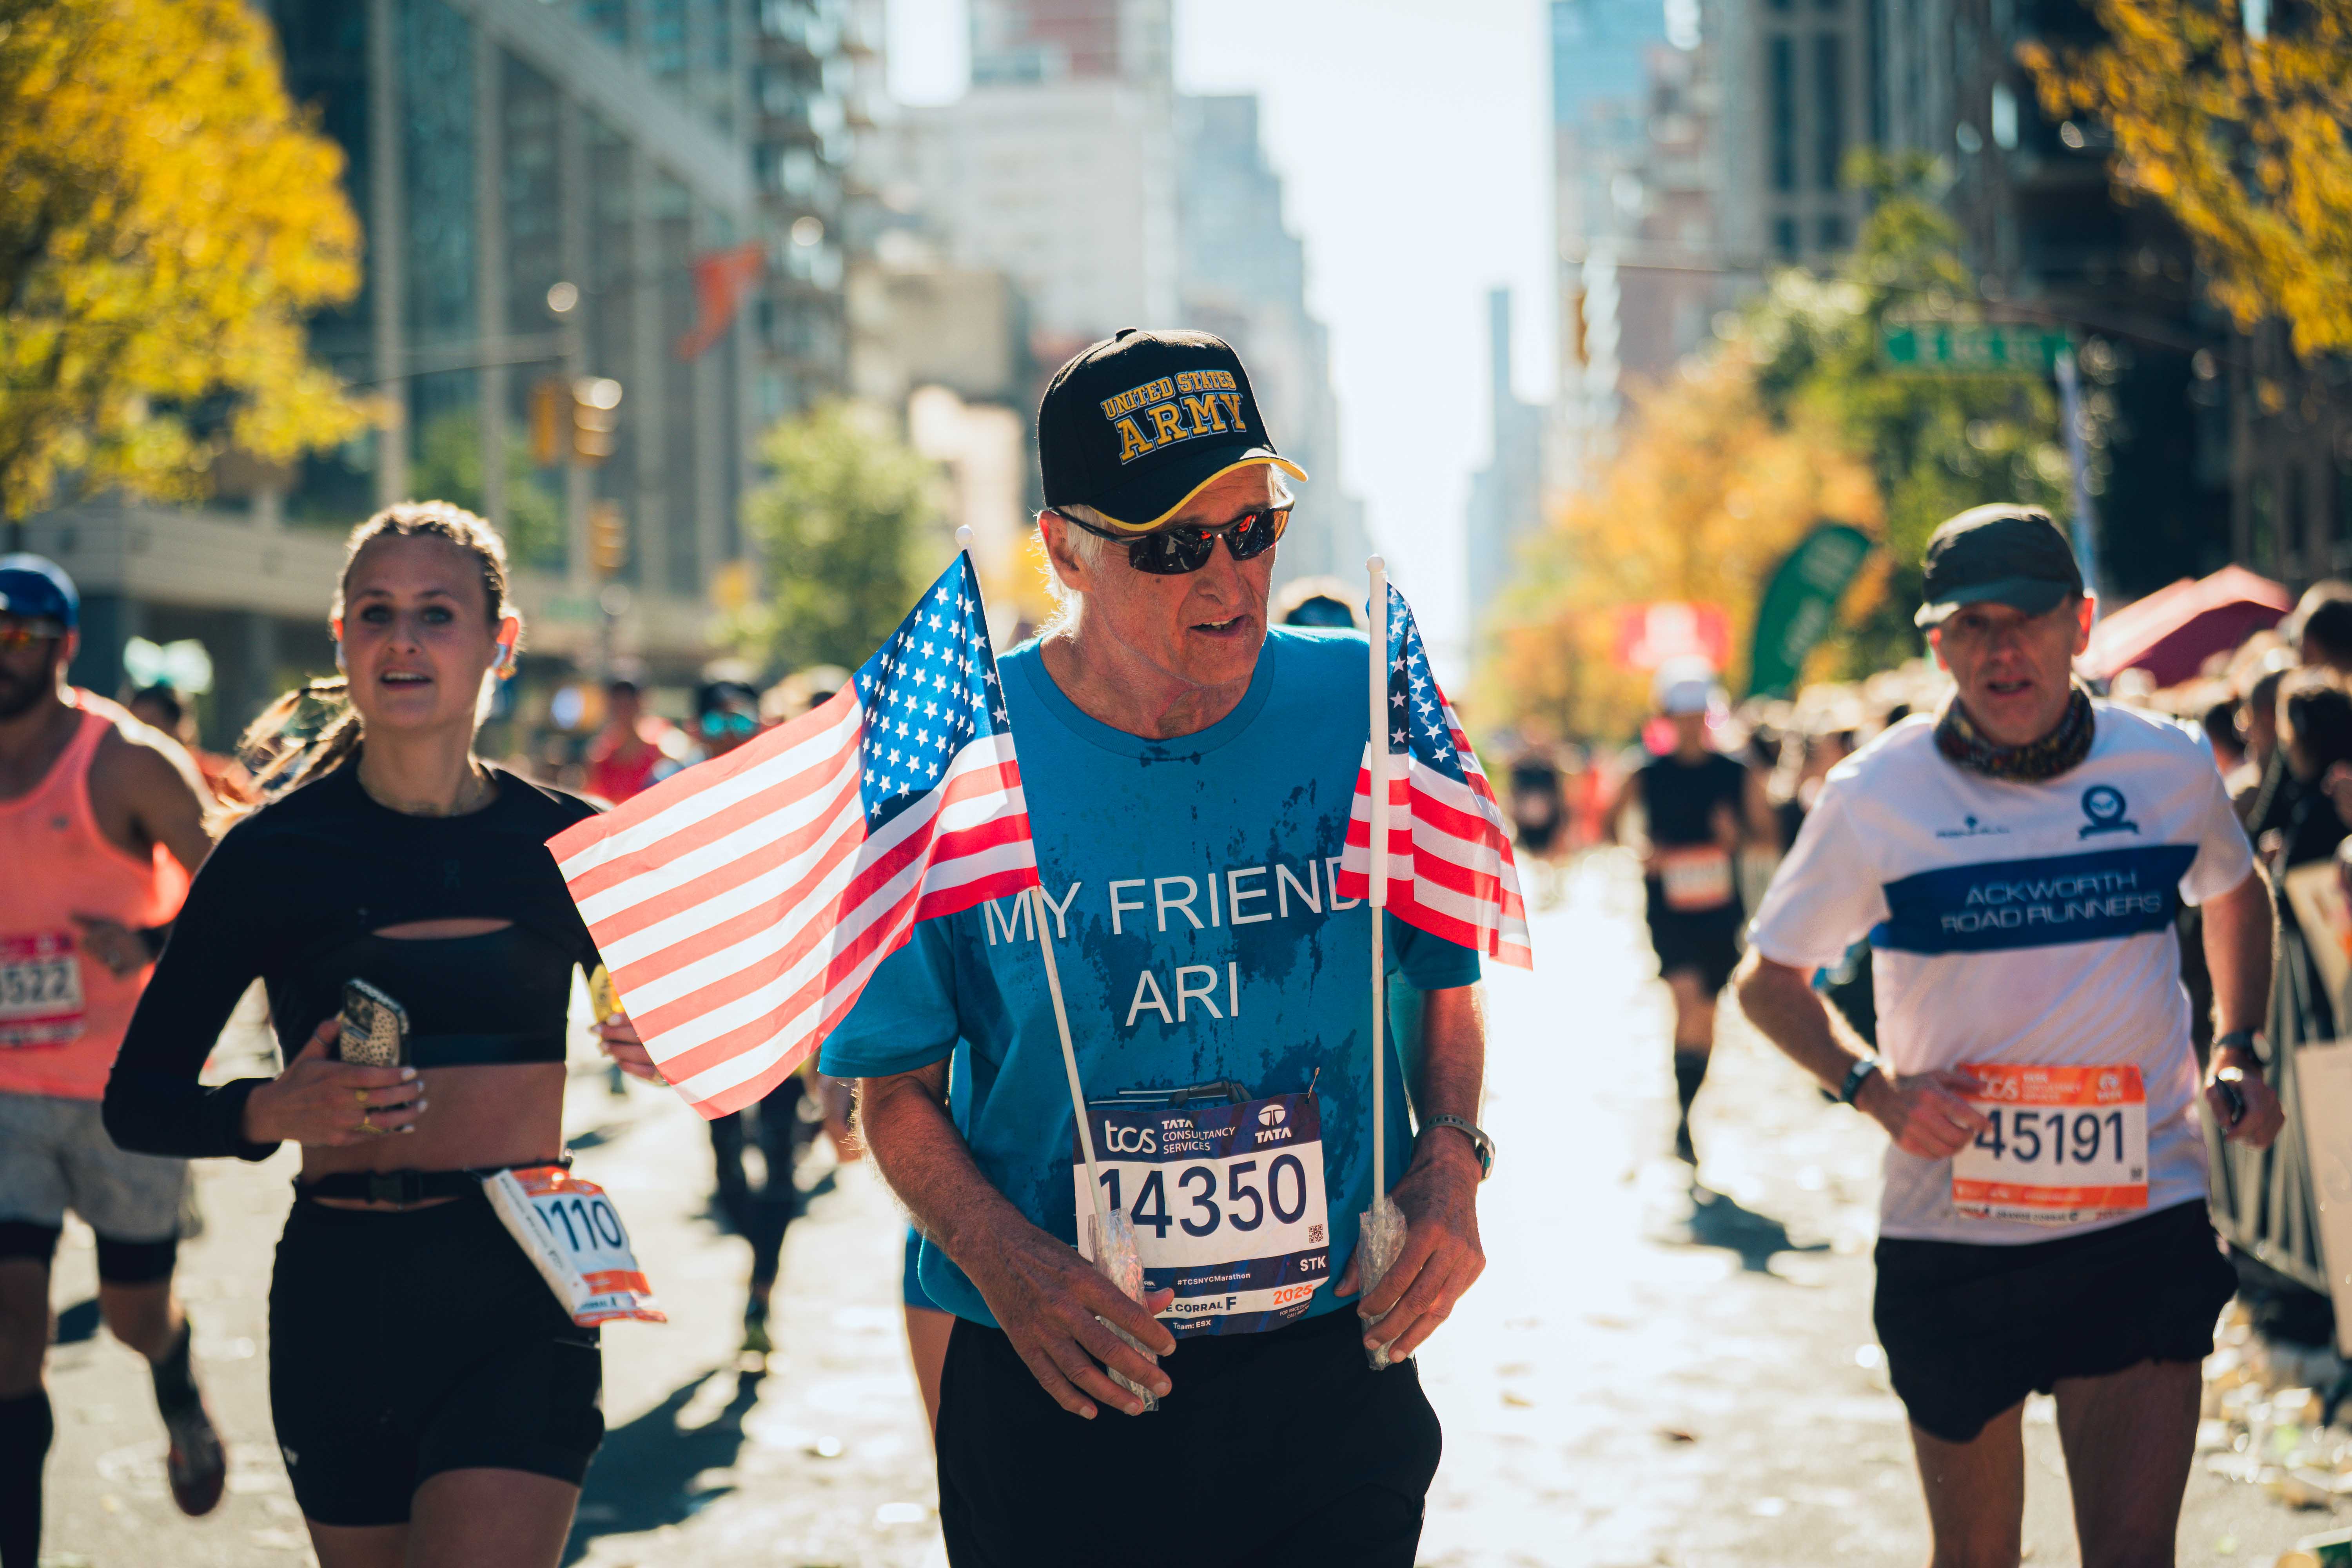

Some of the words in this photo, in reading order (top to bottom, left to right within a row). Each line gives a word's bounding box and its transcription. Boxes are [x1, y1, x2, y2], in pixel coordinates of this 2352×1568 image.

[1101, 377, 1175, 420] UNITED
[1175, 370, 1237, 394] STATES
[1115, 393, 1246, 465] ARMY
[983, 882, 1081, 946] MY
[1109, 856, 1361, 935] FRIEND
[1965, 870, 2138, 907] ACKWORTH
[1940, 907, 2023, 935] ROAD
[2027, 893, 2162, 926] RUNNERS
[0, 958, 71, 1004] 522
[1125, 962, 1238, 1026] ARI
[1105, 1120, 1156, 1154] tcs
[1161, 1119, 1194, 1129] TATA
[1163, 1127, 1236, 1142] CONSULTANCY
[1255, 1127, 1291, 1143] TATA
[1973, 1108, 2123, 1164] 45191
[1163, 1142, 1210, 1154] SERVICES
[1099, 1154, 1307, 1238] 14350
[1177, 1272, 1250, 1286] #TCSNYCMarathon
[1300, 1256, 1326, 1272] STK
[1175, 1301, 1223, 1312] CORRAL
[1226, 1296, 1237, 1311] F
[1273, 1284, 1313, 1305] 2025
[1196, 1319, 1211, 1328] ESX
